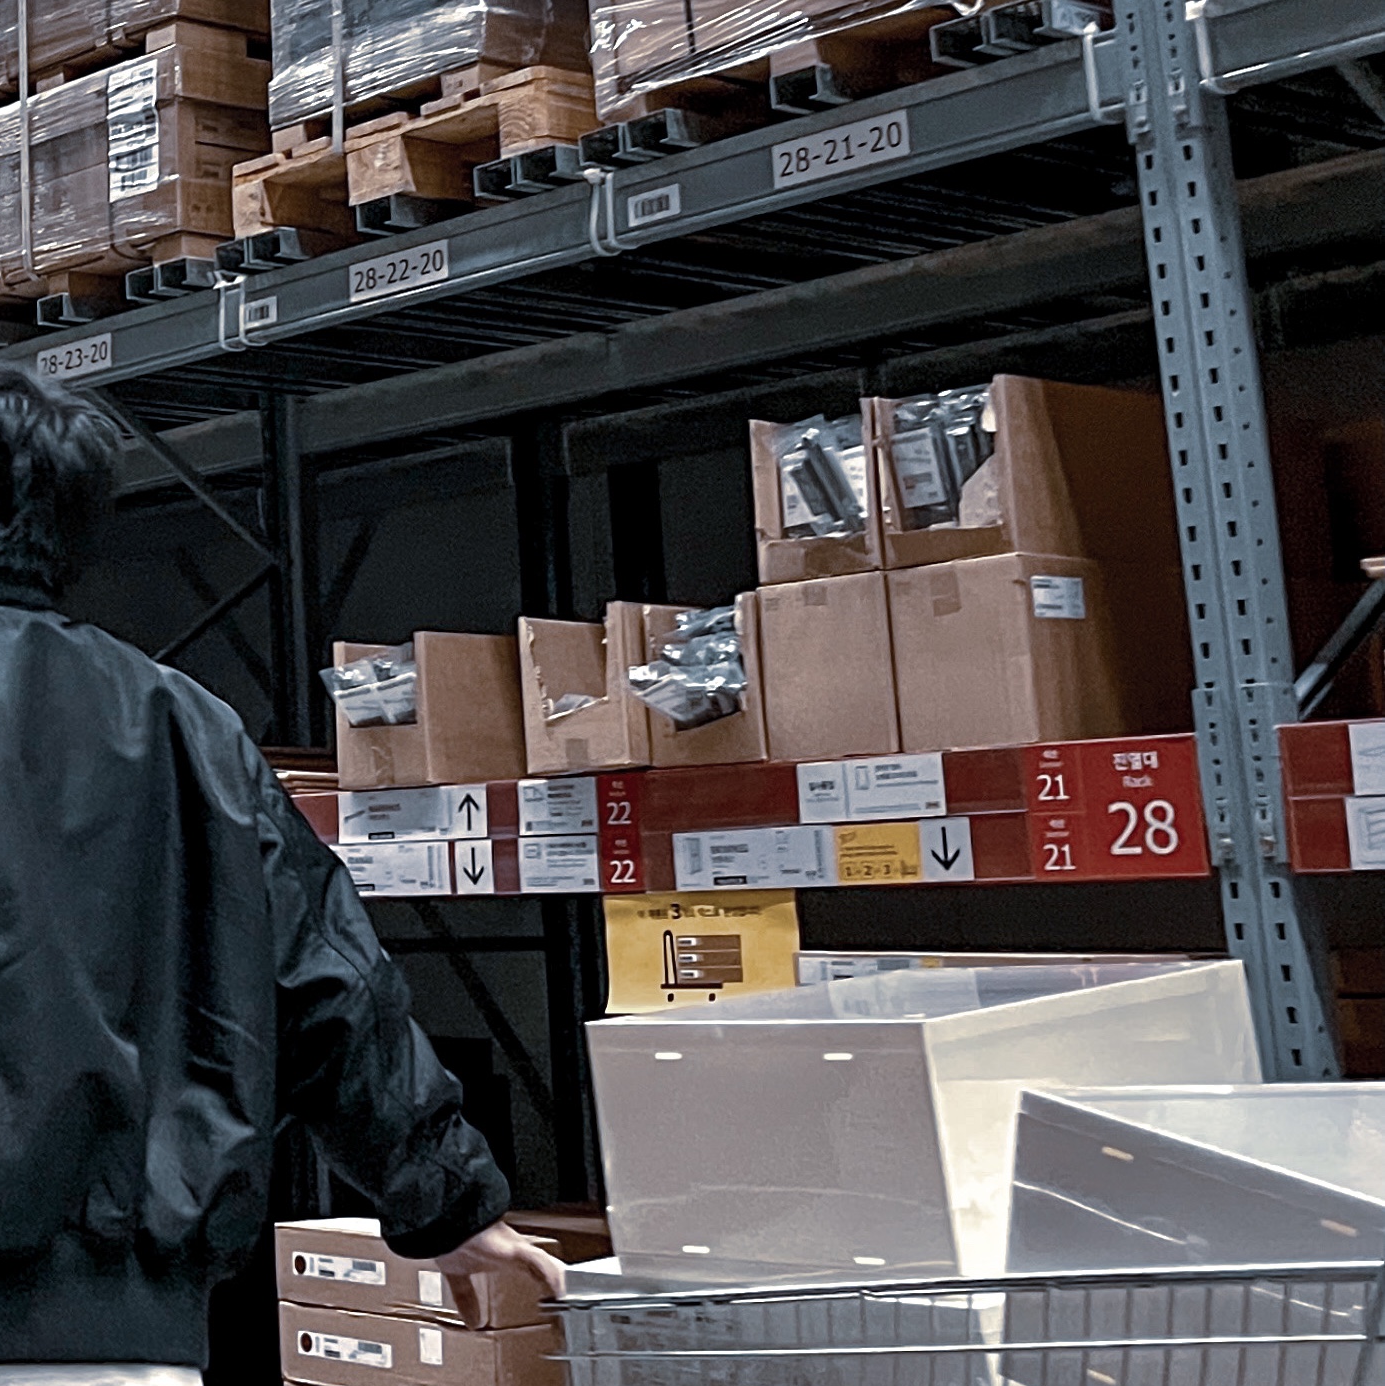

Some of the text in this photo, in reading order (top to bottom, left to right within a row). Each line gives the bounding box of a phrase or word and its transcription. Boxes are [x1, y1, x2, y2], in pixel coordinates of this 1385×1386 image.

[779, 121, 901, 178] 28-21-20
[354, 249, 444, 293] 28-22-20
[1036, 774, 1071, 801] 21
[606, 801, 633, 826] 22
[1107, 799, 1180, 856] 28
[1043, 843, 1077, 871] 21
[609, 859, 637, 884] 22
